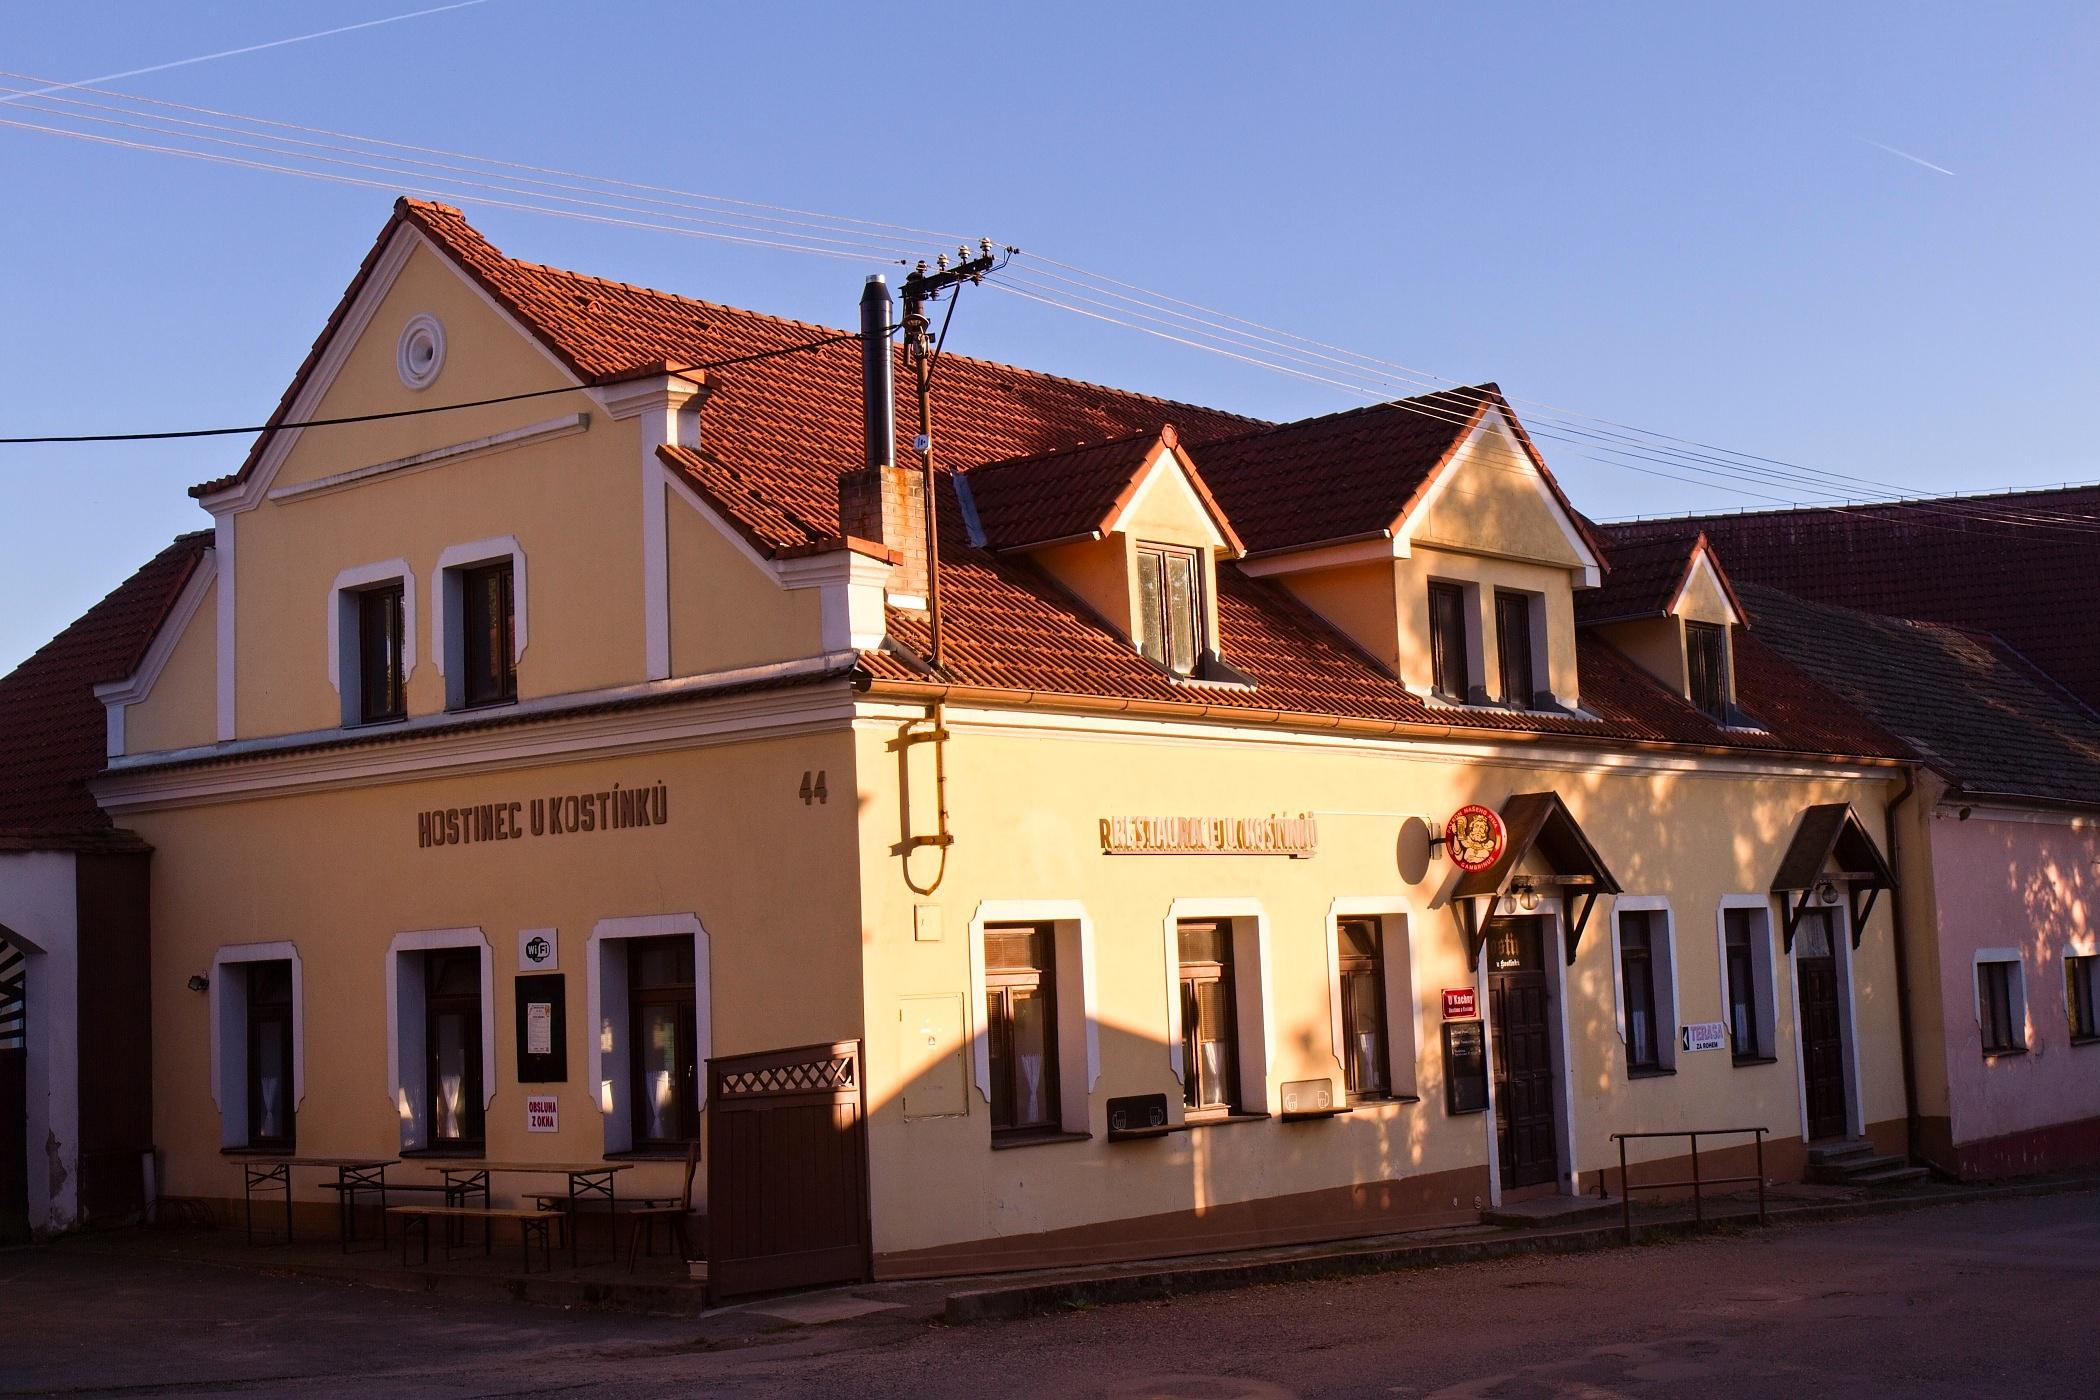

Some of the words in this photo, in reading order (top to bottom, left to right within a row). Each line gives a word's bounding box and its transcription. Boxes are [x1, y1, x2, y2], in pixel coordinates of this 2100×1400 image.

[799, 770, 828, 806] 44
[418, 801, 522, 848] HOSTINEC
[530, 797, 544, 836] U
[549, 780, 668, 835] KOSTÍNKŮ
[1690, 1024, 1723, 1041] TERASA
[532, 1116, 536, 1127] Z
[537, 1116, 554, 1127] OKNA
